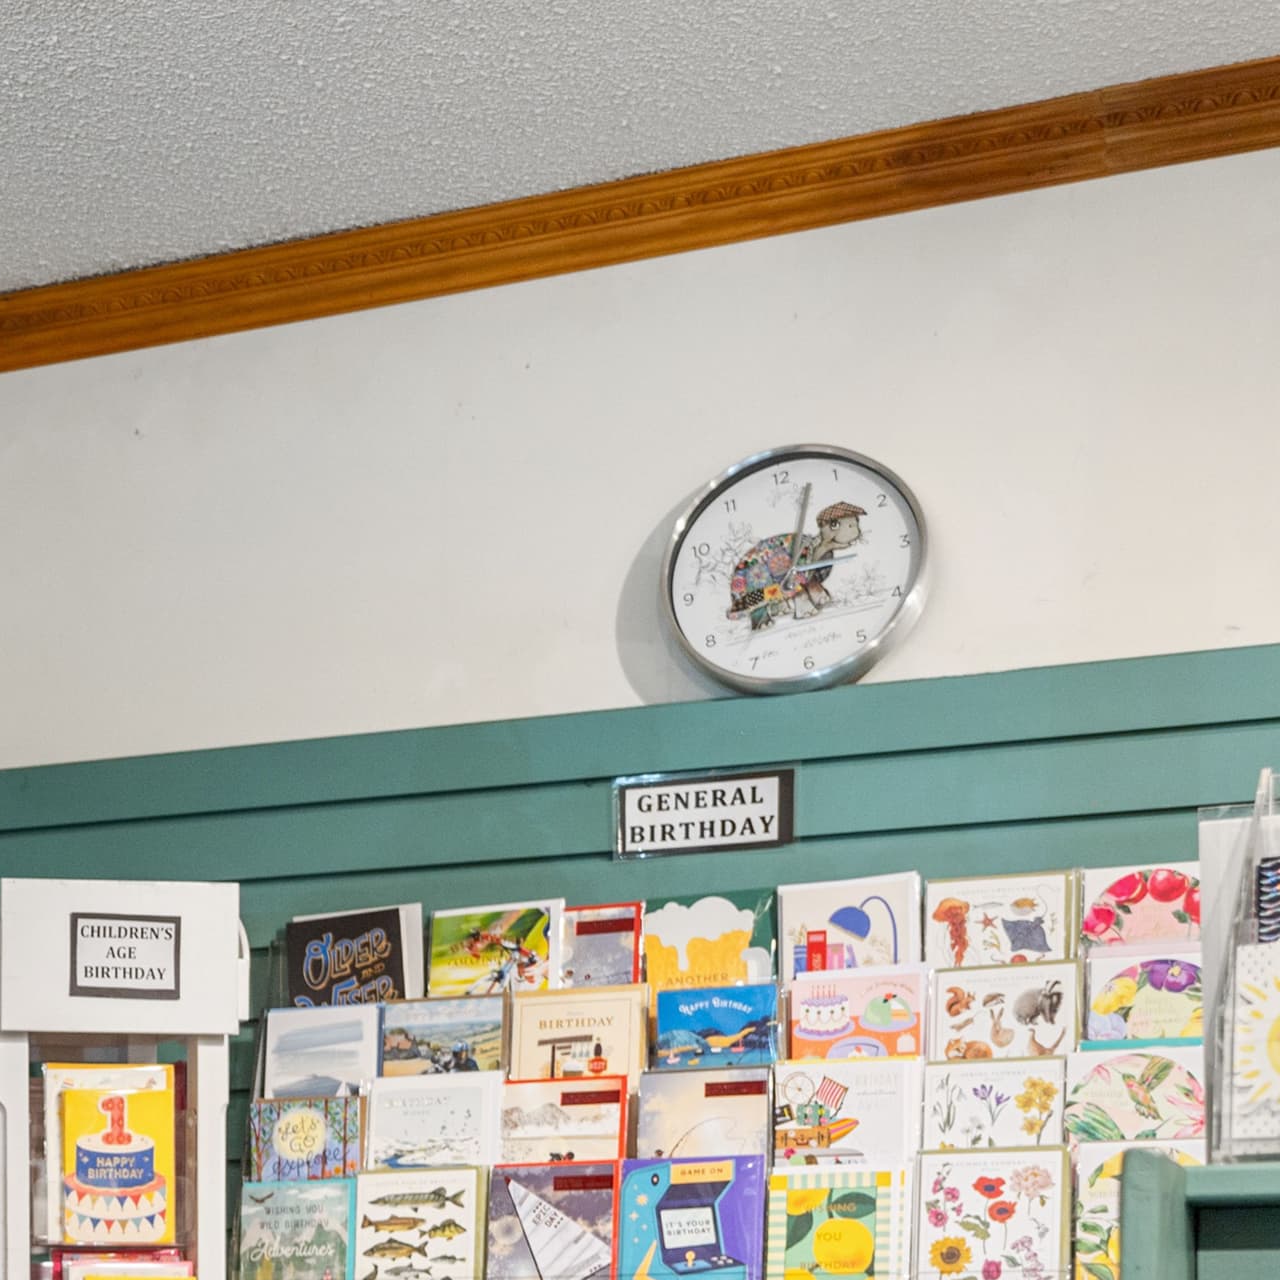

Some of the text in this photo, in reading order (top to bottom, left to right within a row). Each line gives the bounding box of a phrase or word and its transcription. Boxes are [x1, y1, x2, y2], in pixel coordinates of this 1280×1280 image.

[773, 472, 790, 486] 12
[832, 470, 838, 481] 1
[724, 500, 736, 512] 11
[876, 494, 888, 507] 2
[900, 534, 910, 548] 3
[692, 543, 710, 557] 10
[891, 585, 903, 598] 4
[683, 593, 694, 606] 9
[705, 634, 716, 647] 8
[856, 630, 867, 643] 5
[749, 656, 758, 670] 7
[803, 656, 814, 669] 6
[638, 786, 764, 813] GENERAL
[630, 815, 775, 844] BIRTHDAY
[81, 925, 173, 941] CHILDREN'S
[106, 946, 136, 960] AGE
[302, 928, 393, 990] OLDER
[84, 966, 166, 980] BIRTHDAY
[666, 973, 728, 986] ANOTHER
[679, 996, 752, 1015] HAPPY BIRTHDAY
[539, 1015, 614, 1030] BIRTHDAY
[98, 1096, 132, 1145] 1
[96, 1156, 136, 1169] HAPPY
[87, 1167, 145, 1180] BIRTHDAY
[710, 1167, 723, 1175] ON
[265, 1205, 323, 1215] WISHING YOU
[532, 1205, 551, 1226] EPIC
[260, 1220, 280, 1230] WILD
[545, 1212, 560, 1228] DAY
[688, 1219, 710, 1227] YOUR
[667, 1228, 711, 1236] BIRTHDAY
[816, 1231, 842, 1242] YOU
[250, 1239, 335, 1261] Adventures
